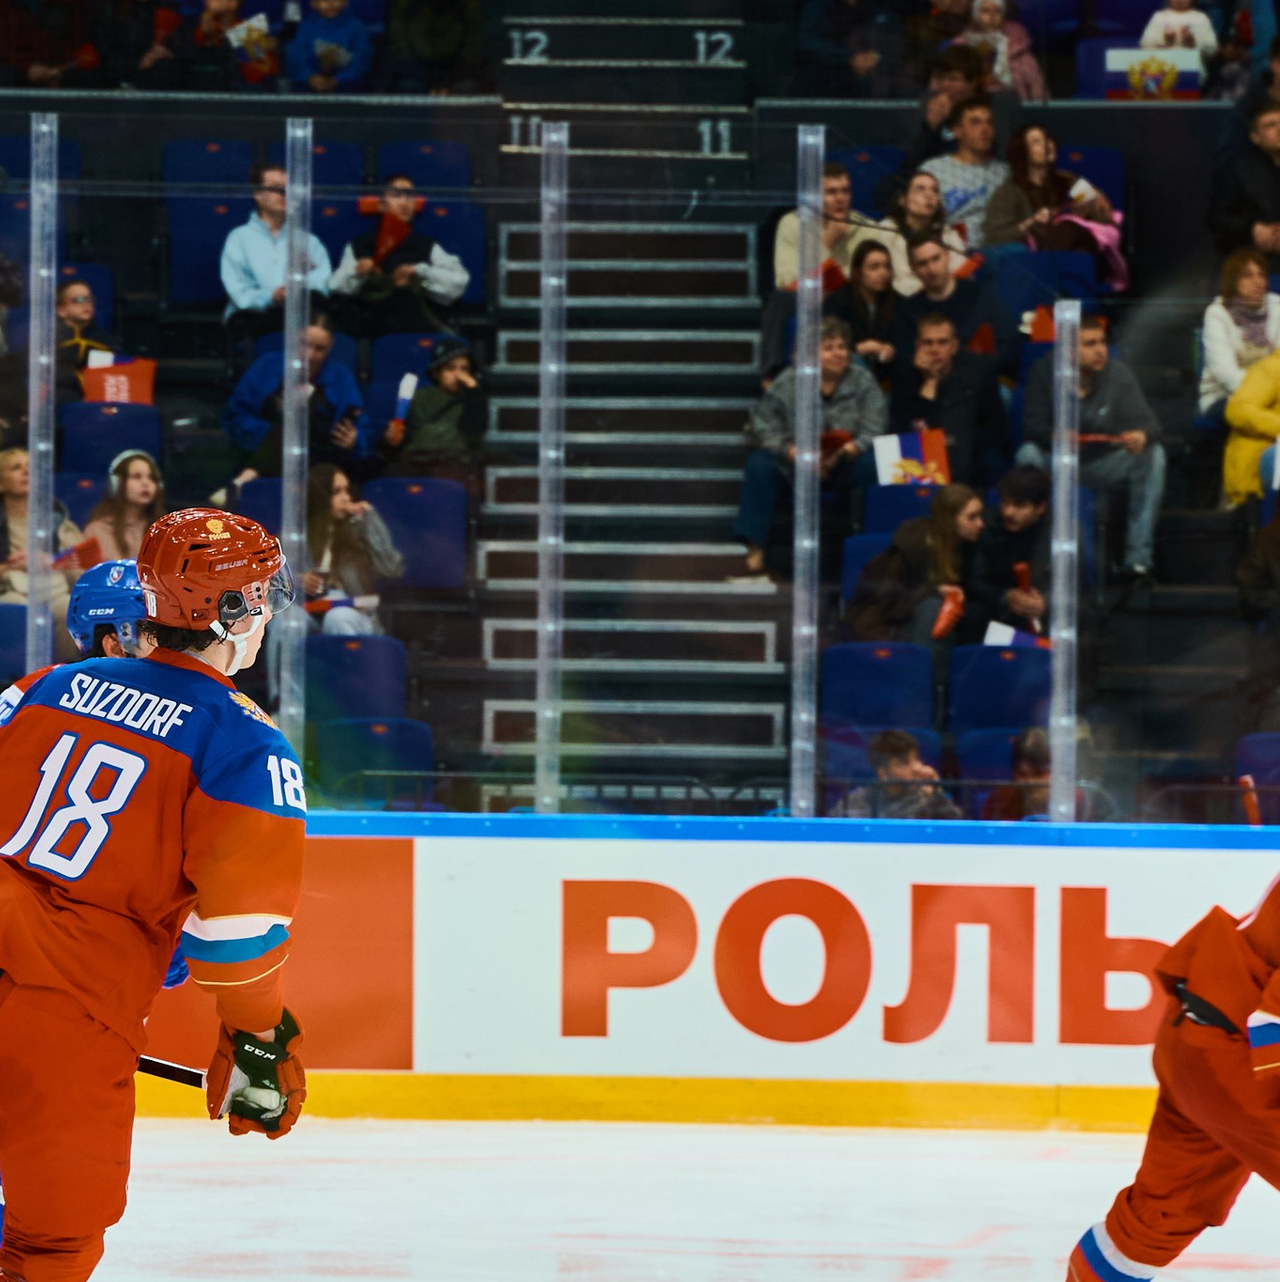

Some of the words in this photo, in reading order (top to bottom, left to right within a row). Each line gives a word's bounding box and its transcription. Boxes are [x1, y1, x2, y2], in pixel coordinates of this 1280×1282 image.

[507, 29, 550, 60] 12
[693, 30, 734, 63] 12
[697, 118, 732, 153] 11
[88, 607, 115, 616] CCM
[59, 673, 193, 738] SUZDORF
[266, 755, 307, 812] 18
[243, 1044, 276, 1061] CCM
